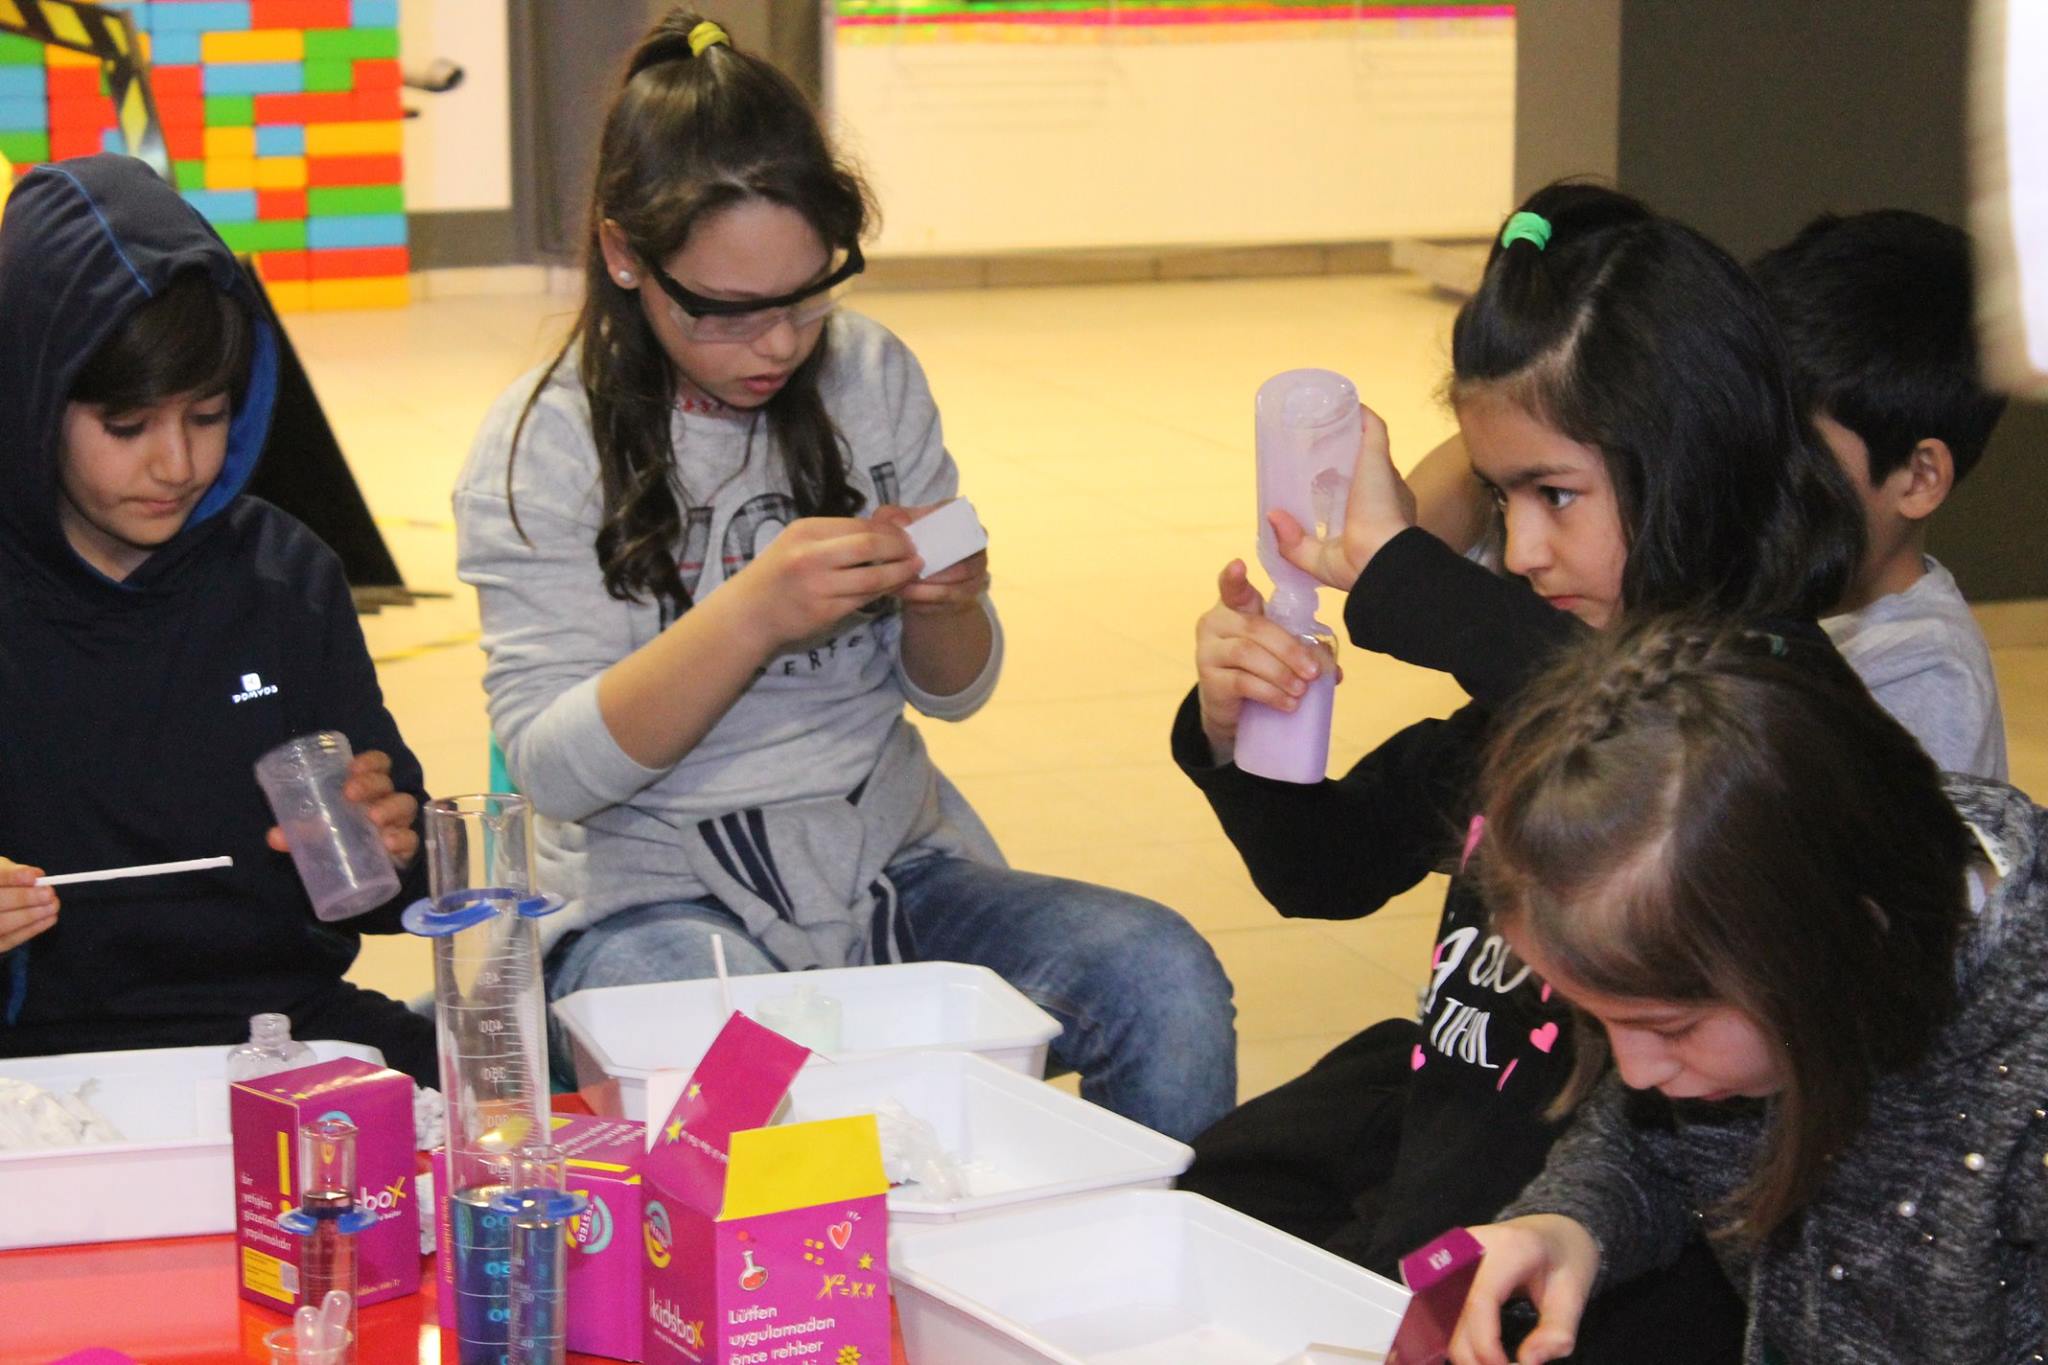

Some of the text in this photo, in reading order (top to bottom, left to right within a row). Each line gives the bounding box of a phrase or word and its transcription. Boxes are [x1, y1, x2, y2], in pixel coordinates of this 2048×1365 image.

[728, 1305, 777, 1325] Lütfen
[729, 1316, 835, 1348] uygulamadan
[729, 1340, 824, 1365] önce rehber
